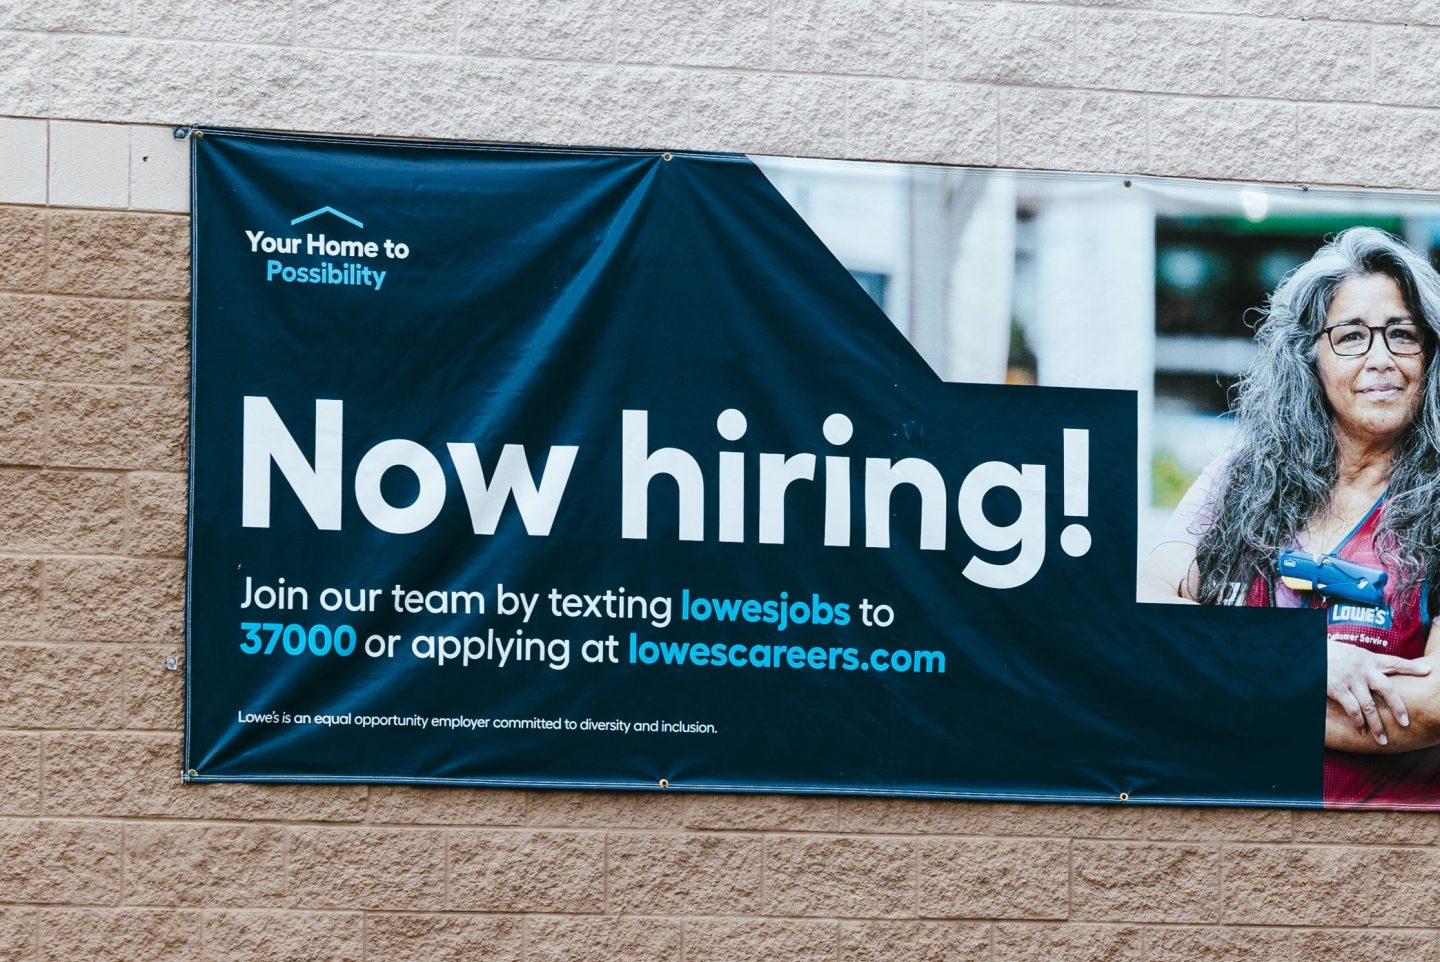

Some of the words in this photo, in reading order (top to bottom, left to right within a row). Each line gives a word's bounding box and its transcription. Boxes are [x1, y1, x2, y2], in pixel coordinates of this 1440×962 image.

[245, 230, 303, 256] Your
[306, 233, 378, 258] Home
[384, 238, 410, 260] to
[266, 259, 387, 291] Possibility
[242, 395, 579, 536] Now
[622, 408, 1093, 590] hiring!
[240, 576, 309, 610] Join
[319, 587, 382, 612] our
[391, 584, 485, 614] team
[497, 583, 539, 623] by
[548, 587, 672, 628] texting
[681, 589, 850, 631] lowesjobs
[858, 599, 895, 627] to
[1332, 604, 1386, 625] LOWE'S
[240, 622, 357, 657] 37000
[364, 634, 401, 658] or
[411, 629, 571, 671] applying
[581, 635, 619, 663] at
[629, 632, 946, 673] lowescareers.com
[1360, 633, 1389, 647] Service
[238, 710, 280, 724] Lowe's
[281, 711, 292, 724] is
[294, 715, 311, 724] an
[314, 713, 351, 727] equal
[354, 714, 428, 729] opportunity
[431, 716, 490, 730] employer
[493, 717, 561, 730] committed
[564, 718, 578, 730] to
[580, 718, 631, 734] diversity
[633, 720, 659, 733] and
[661, 720, 718, 734] inclusion.
